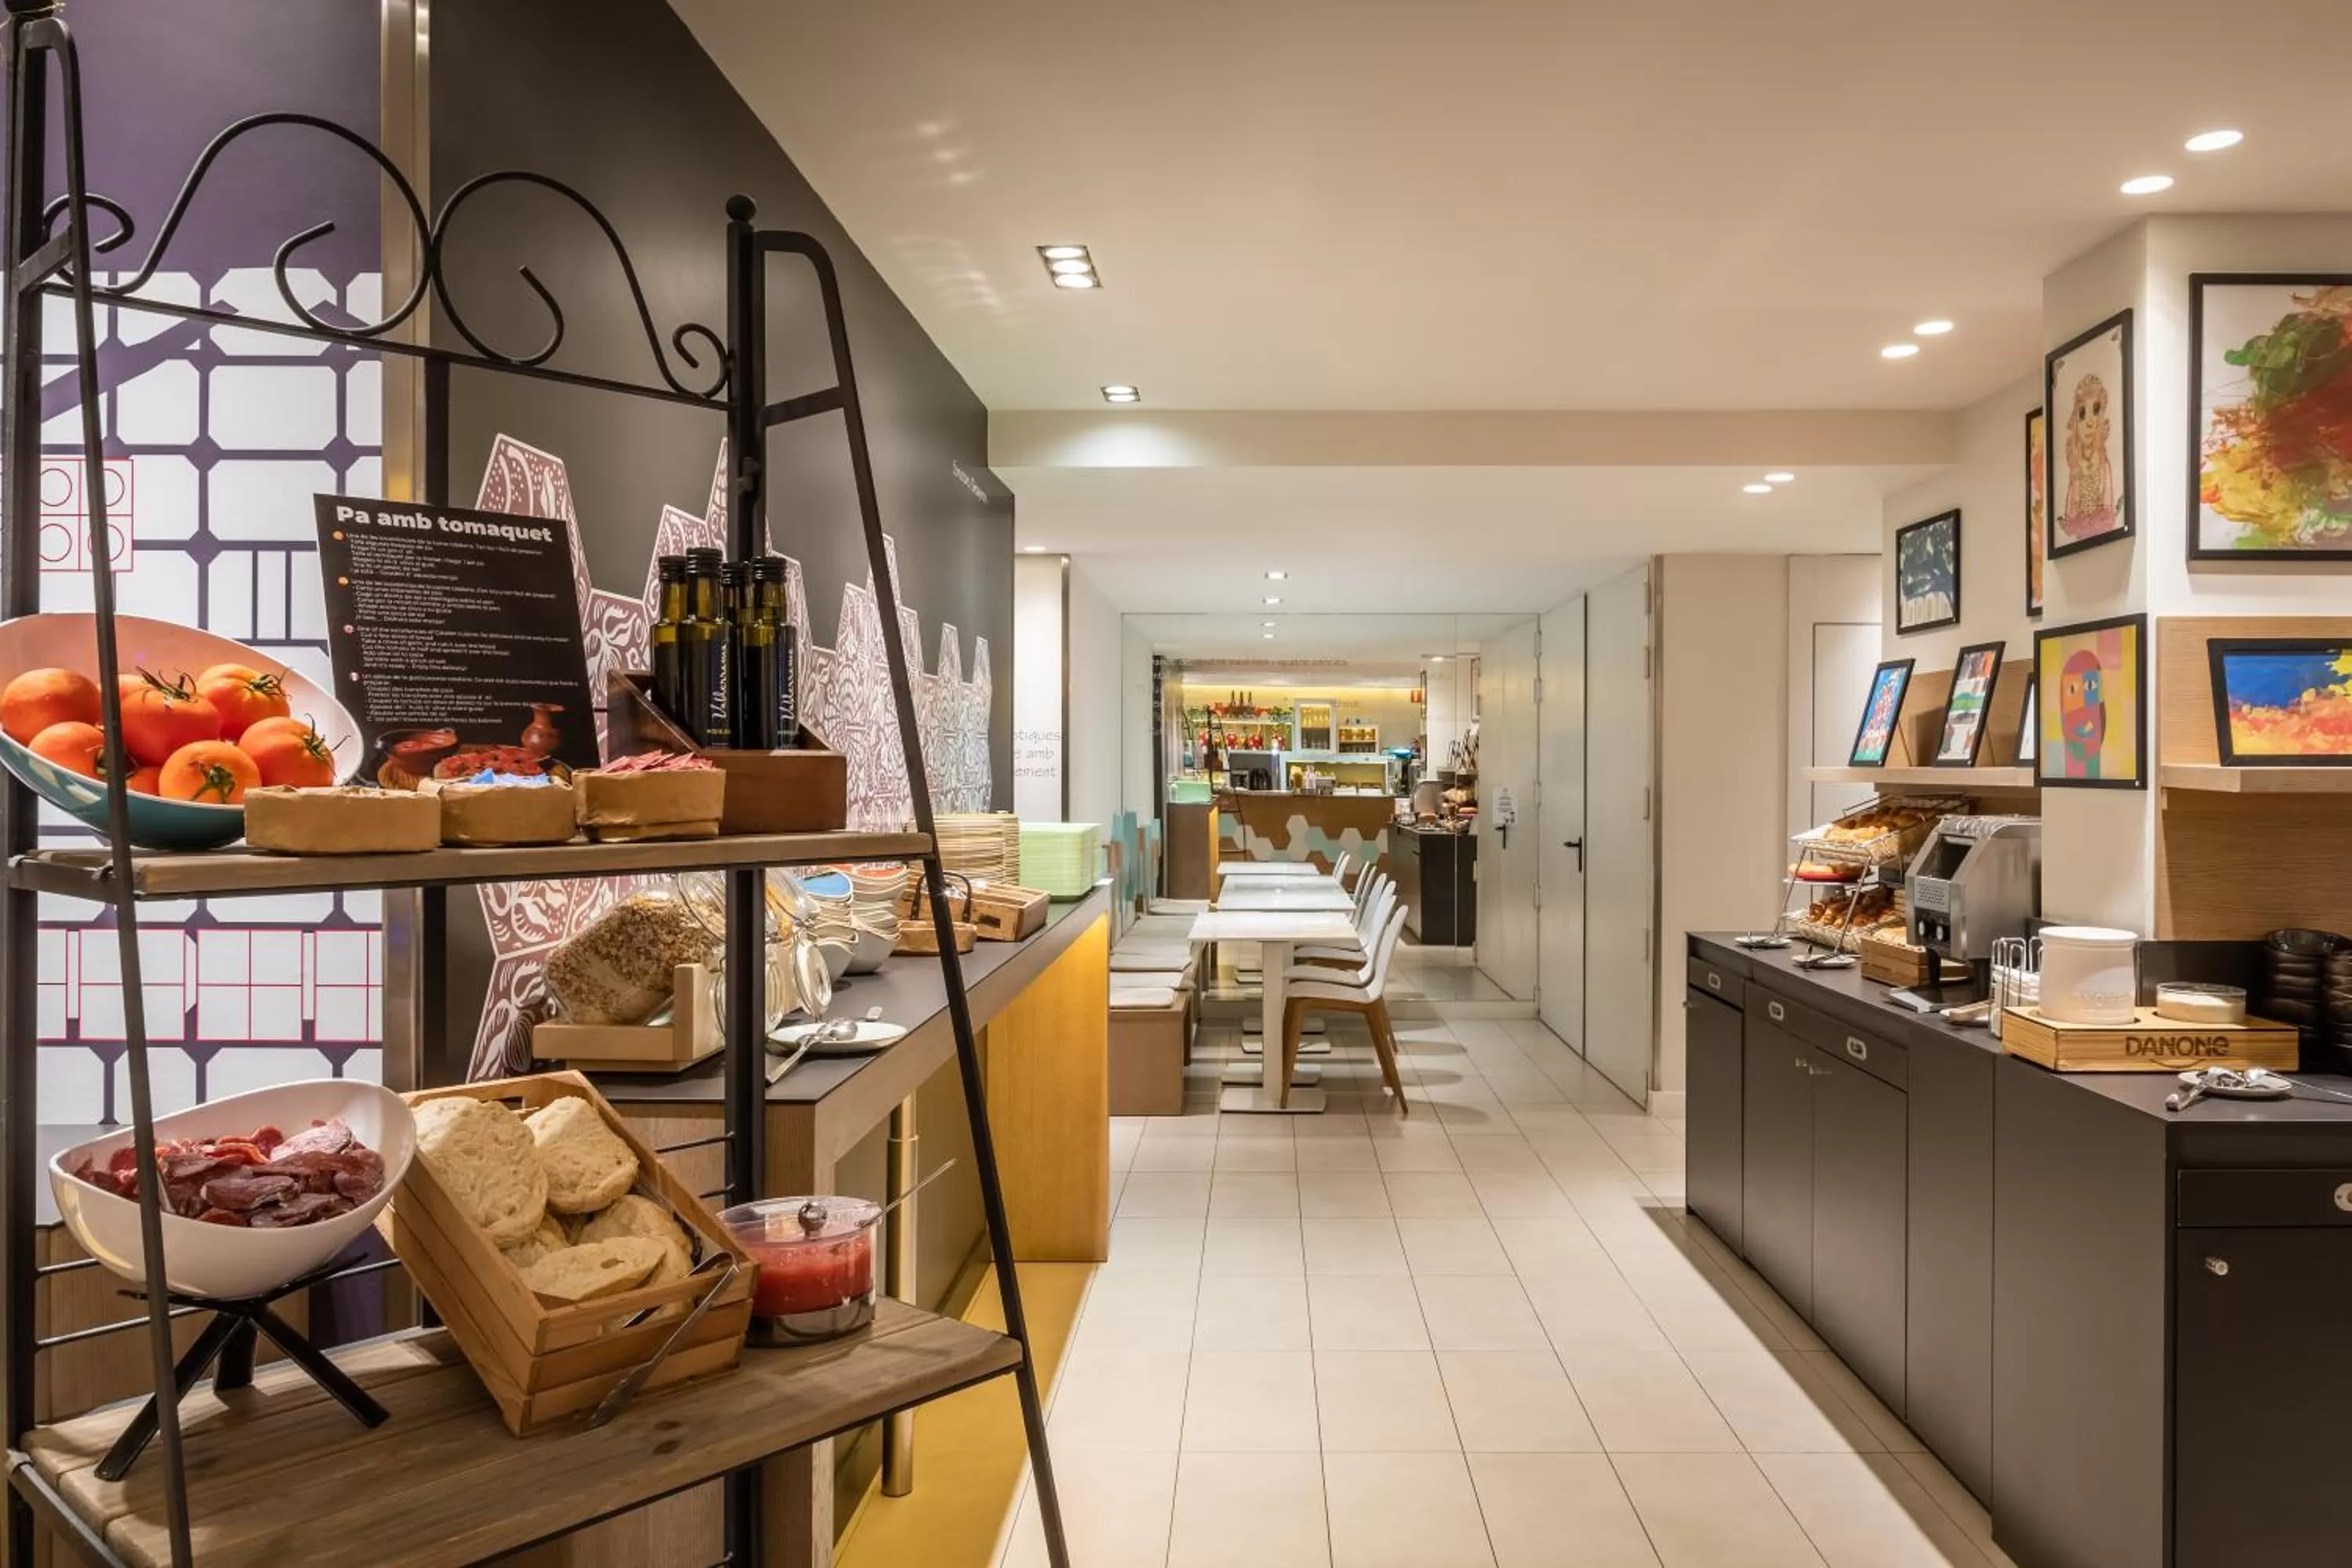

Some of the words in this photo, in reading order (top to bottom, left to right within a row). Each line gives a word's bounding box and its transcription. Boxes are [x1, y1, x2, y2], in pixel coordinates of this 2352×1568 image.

[336, 506, 370, 524] Pa
[377, 511, 431, 530] amb
[437, 516, 553, 542] tomaquet
